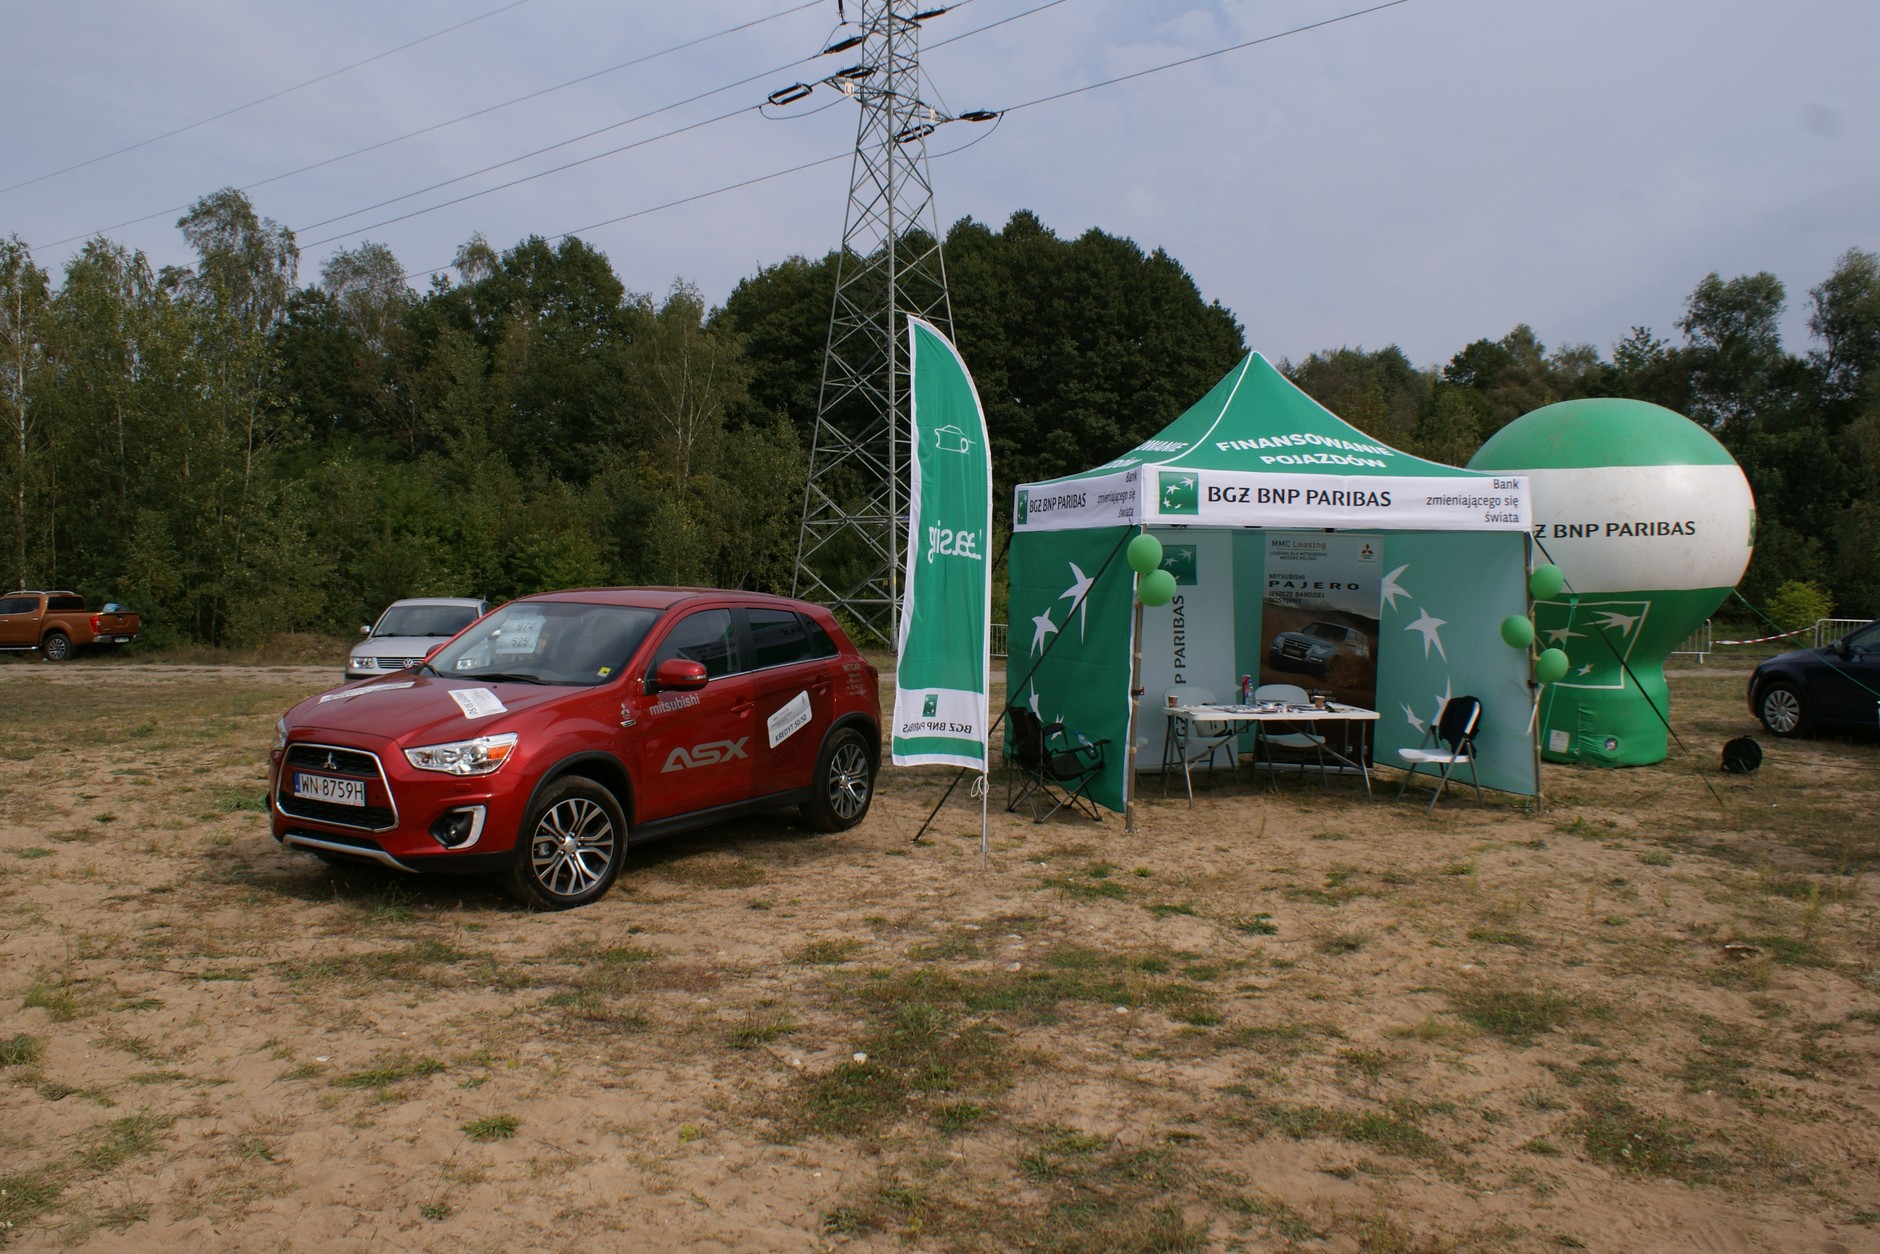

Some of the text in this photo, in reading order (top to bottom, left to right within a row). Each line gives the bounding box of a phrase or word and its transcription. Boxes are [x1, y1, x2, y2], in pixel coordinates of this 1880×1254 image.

[1215, 433, 1395, 457] FINANSOWANIE
[1259, 453, 1387, 468] POJAZDÓW
[1125, 471, 1138, 483] Bank
[1492, 479, 1520, 490] Bank
[1043, 496, 1057, 512] BNP
[1057, 492, 1087, 511] PARIBAS
[1257, 487, 1301, 505] BNP
[1306, 489, 1392, 507] PARIBAS
[1426, 494, 1519, 509] zmieniającego się
[1484, 511, 1519, 523] świata
[1553, 523, 1600, 539] BNP
[1605, 520, 1696, 537] PARIBAS
[1271, 540, 1327, 550] MMC Leasing
[1268, 573, 1306, 581] MITSUBISHI
[1268, 580, 1360, 591] PAJERO
[1295, 591, 1325, 599] BARDZIEJ
[1172, 594, 1187, 669] PARIBAS
[649, 693, 701, 716] mitsubishi
[660, 736, 750, 774] ASX
[301, 774, 365, 801] WN 8759H
